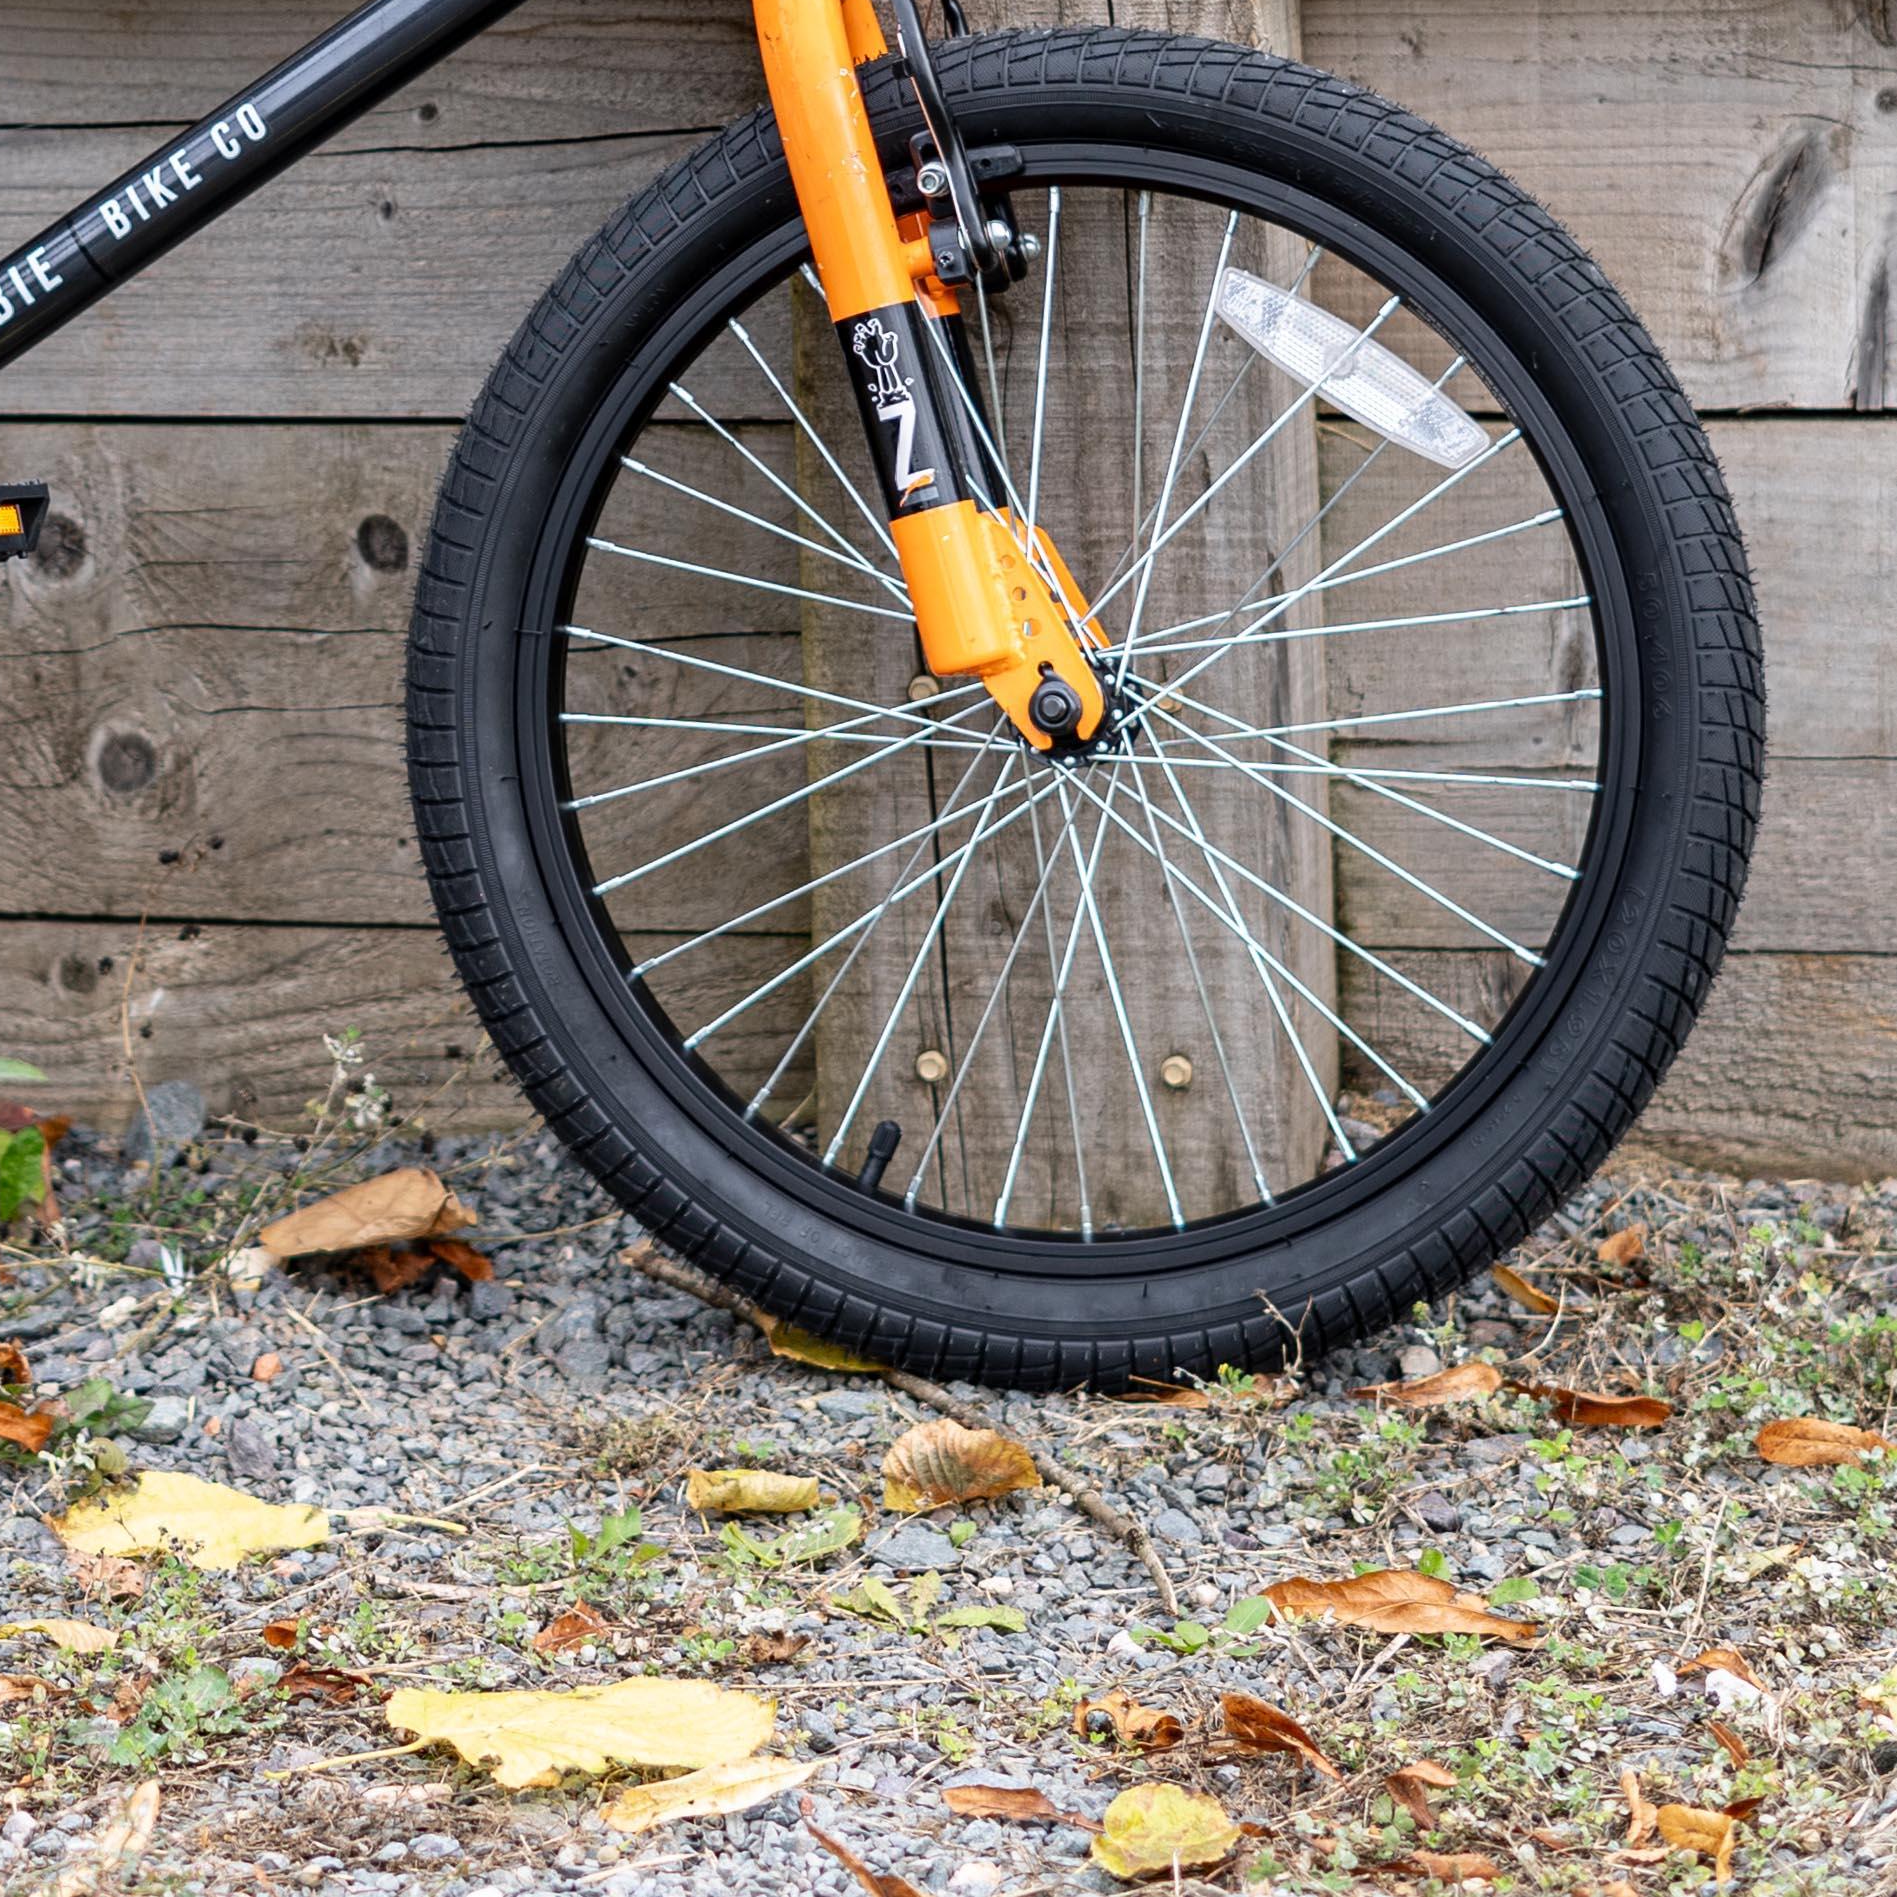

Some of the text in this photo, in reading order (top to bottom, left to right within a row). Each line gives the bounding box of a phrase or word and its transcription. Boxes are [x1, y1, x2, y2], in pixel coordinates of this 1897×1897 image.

[98, 149, 203, 240] BIKE
[210, 102, 268, 160] CO
[515, 903, 564, 989] ROTATION
